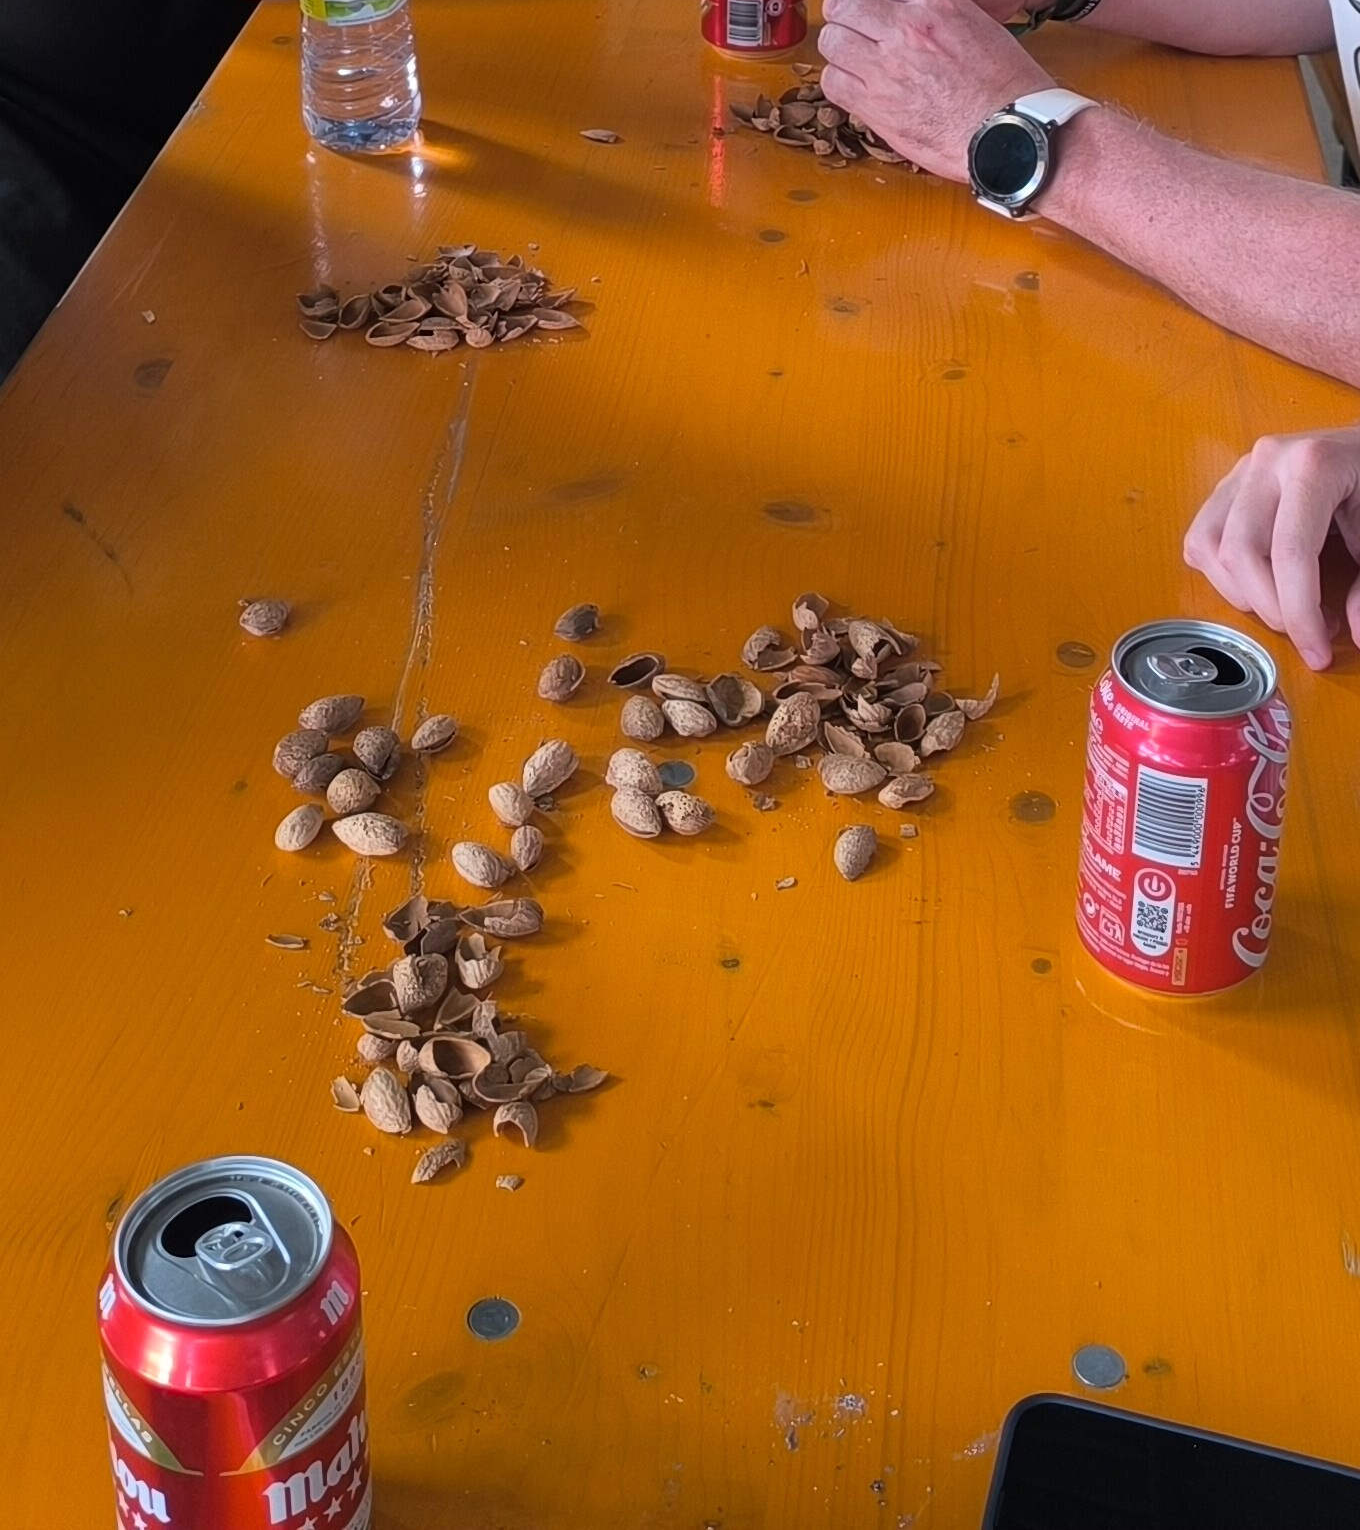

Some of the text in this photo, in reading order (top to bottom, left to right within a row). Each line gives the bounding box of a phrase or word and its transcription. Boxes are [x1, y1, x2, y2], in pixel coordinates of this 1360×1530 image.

[1228, 845, 1241, 885] WORLD
[1225, 884, 1237, 909] FIFA
[272, 1381, 328, 1447] CINCO
